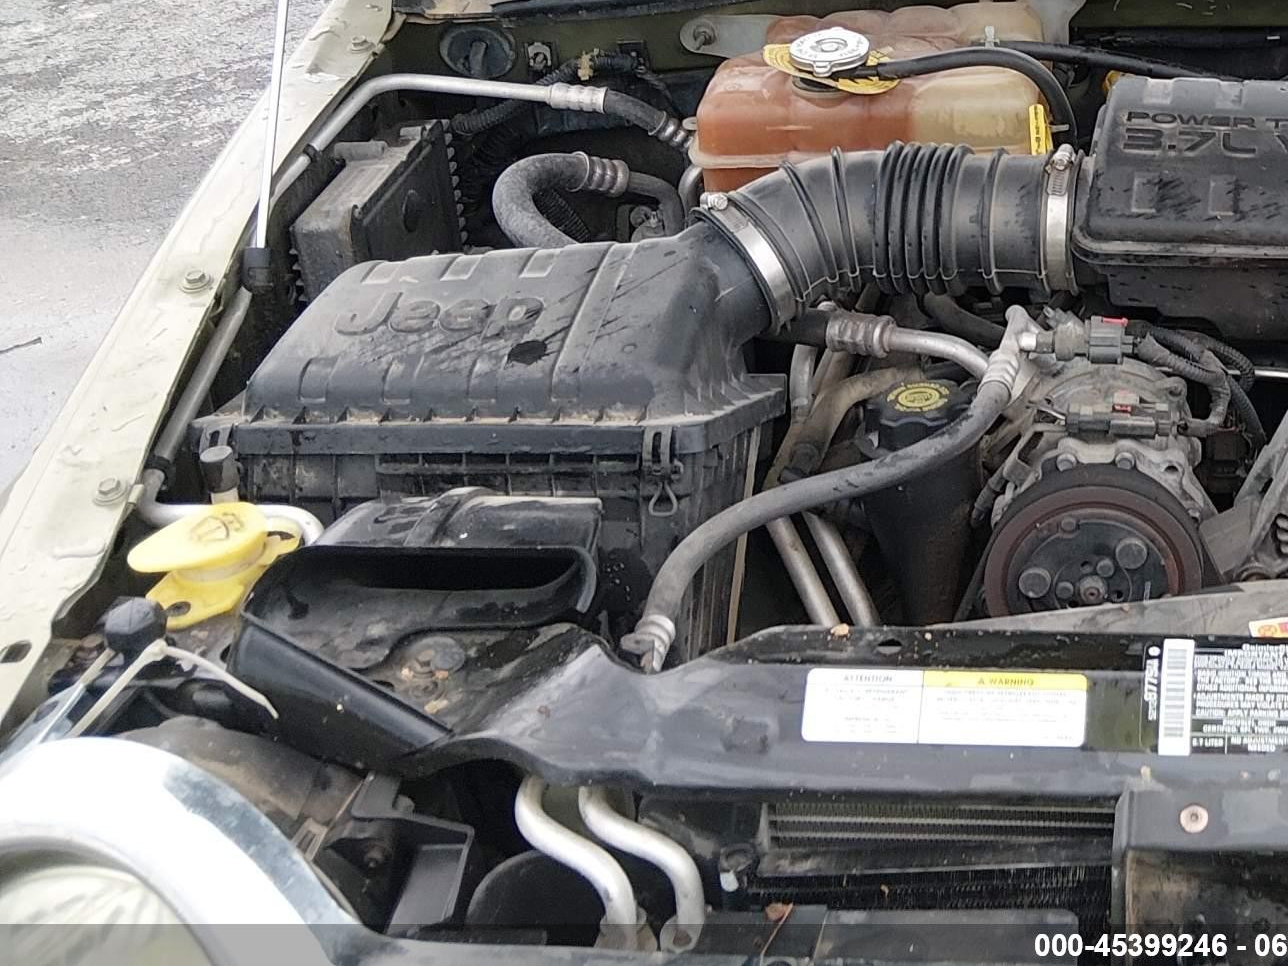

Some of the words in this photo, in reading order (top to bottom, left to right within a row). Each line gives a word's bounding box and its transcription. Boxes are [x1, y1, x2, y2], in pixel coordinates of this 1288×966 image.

[1126, 110, 1256, 130] POWER
[1122, 127, 1258, 156] 3.7L
[334, 290, 545, 340] Jeep
[843, 674, 893, 683] ATTENTION
[989, 677, 1035, 686] WARNING
